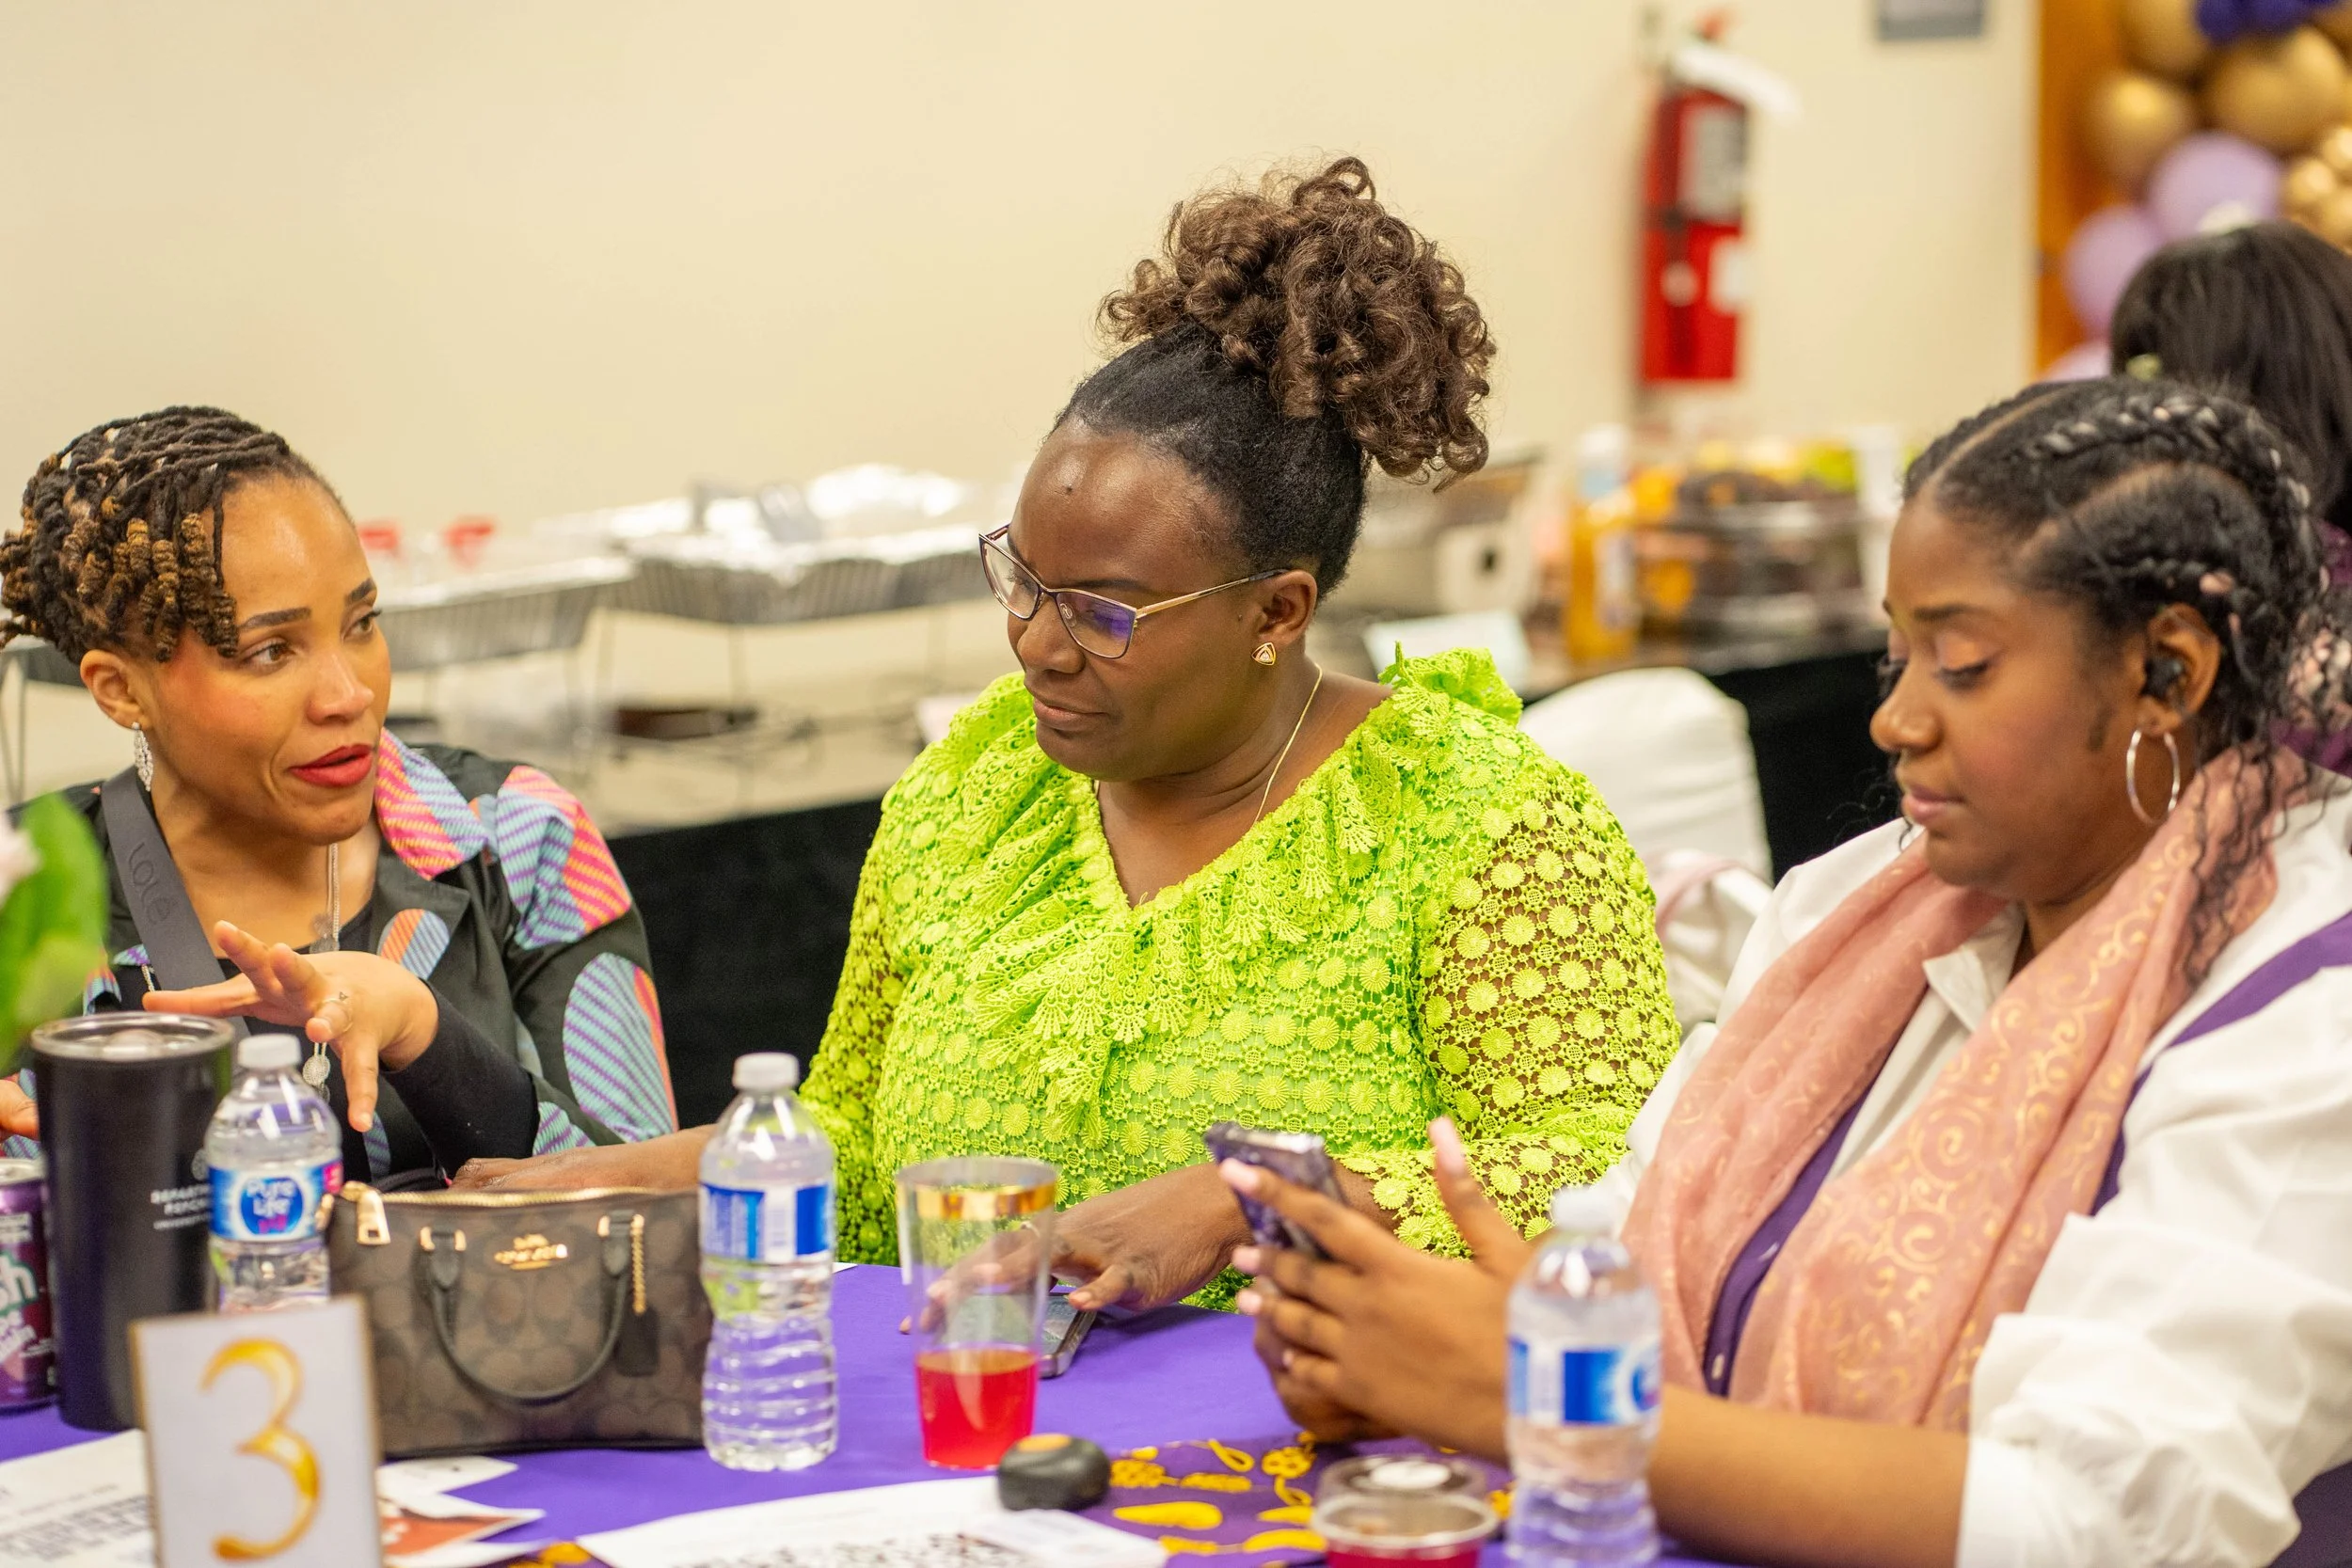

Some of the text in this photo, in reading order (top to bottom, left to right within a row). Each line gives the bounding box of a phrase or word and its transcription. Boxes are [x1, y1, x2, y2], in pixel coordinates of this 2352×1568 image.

[246, 1178, 297, 1201] Pure
[252, 1196, 291, 1218] Life
[199, 1336, 323, 1562] 3
